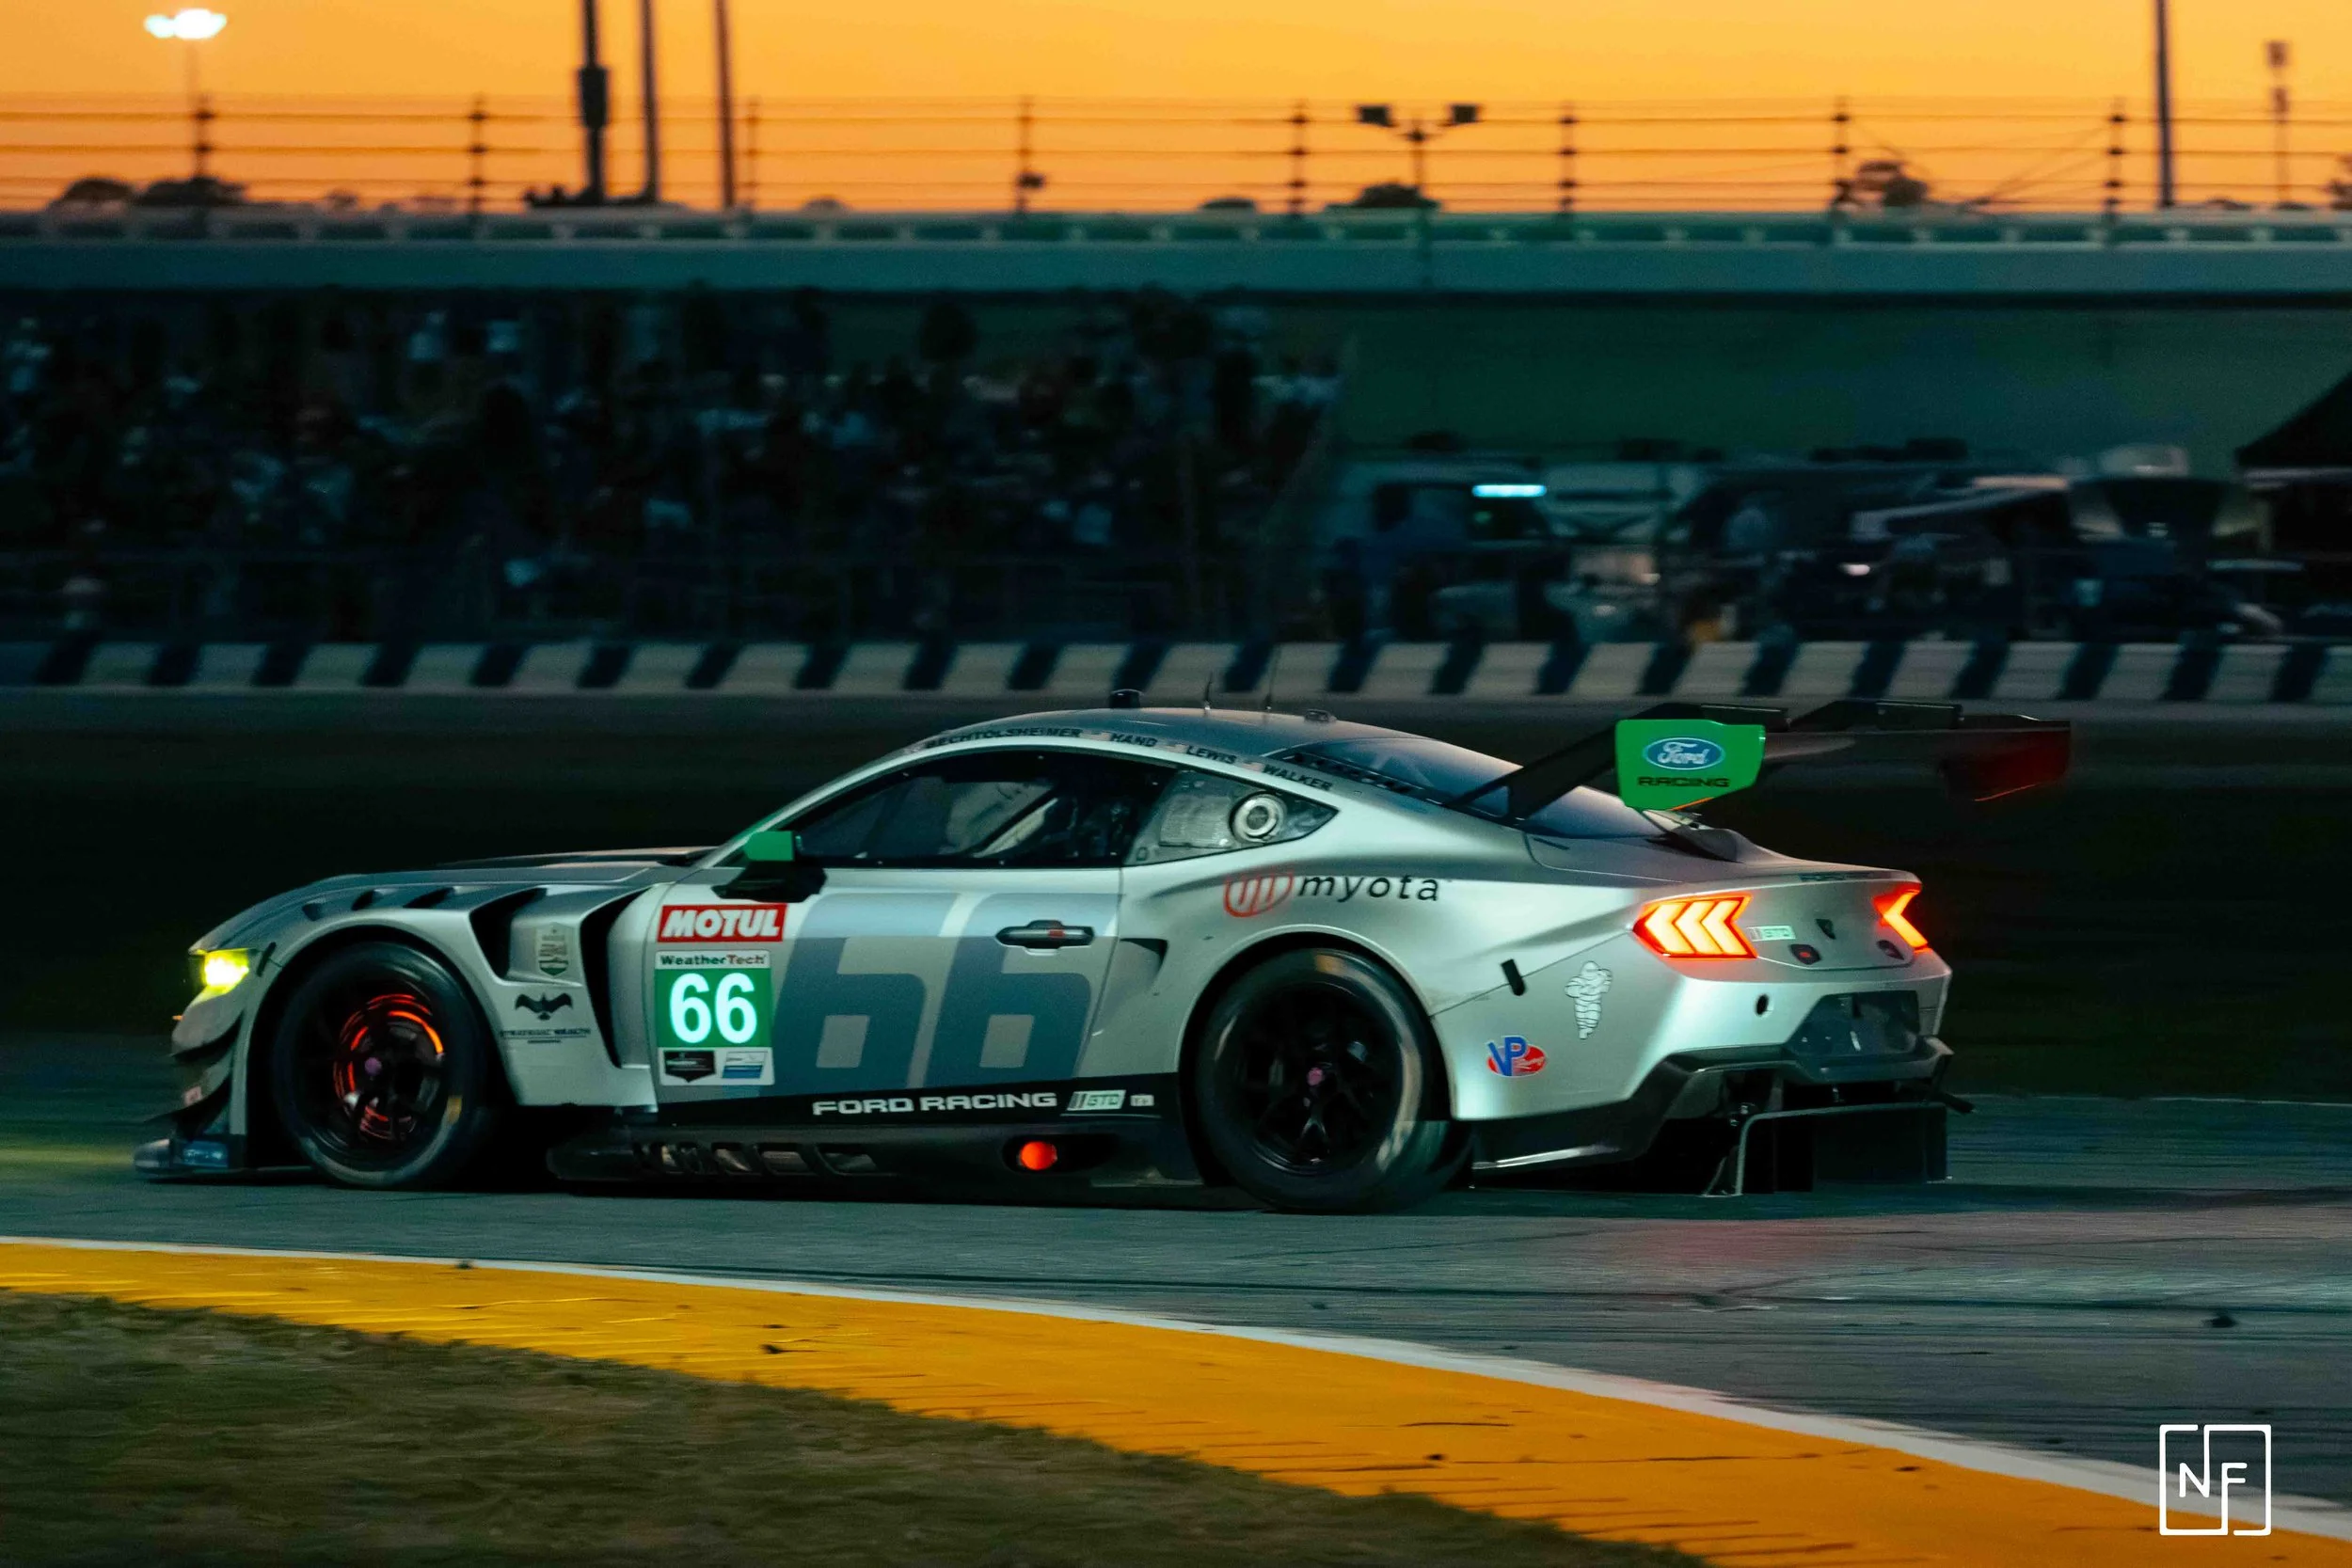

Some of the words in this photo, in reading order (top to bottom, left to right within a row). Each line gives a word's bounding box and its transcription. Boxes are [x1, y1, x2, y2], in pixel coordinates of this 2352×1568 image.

[1111, 733, 1158, 748] HAND
[1185, 745, 1238, 765] LEWIS
[1263, 763, 1333, 792] WALKER
[1658, 741, 1710, 765] Ford
[1638, 776, 1730, 788] RACING
[1296, 874, 1439, 903] myota
[661, 909, 780, 938] MOTUL
[660, 954, 765, 965] WeatherTech
[669, 972, 757, 1044] 66
[1486, 1035, 1527, 1076] VP
[812, 1098, 914, 1116] FORD
[919, 1092, 1057, 1111] RACING
